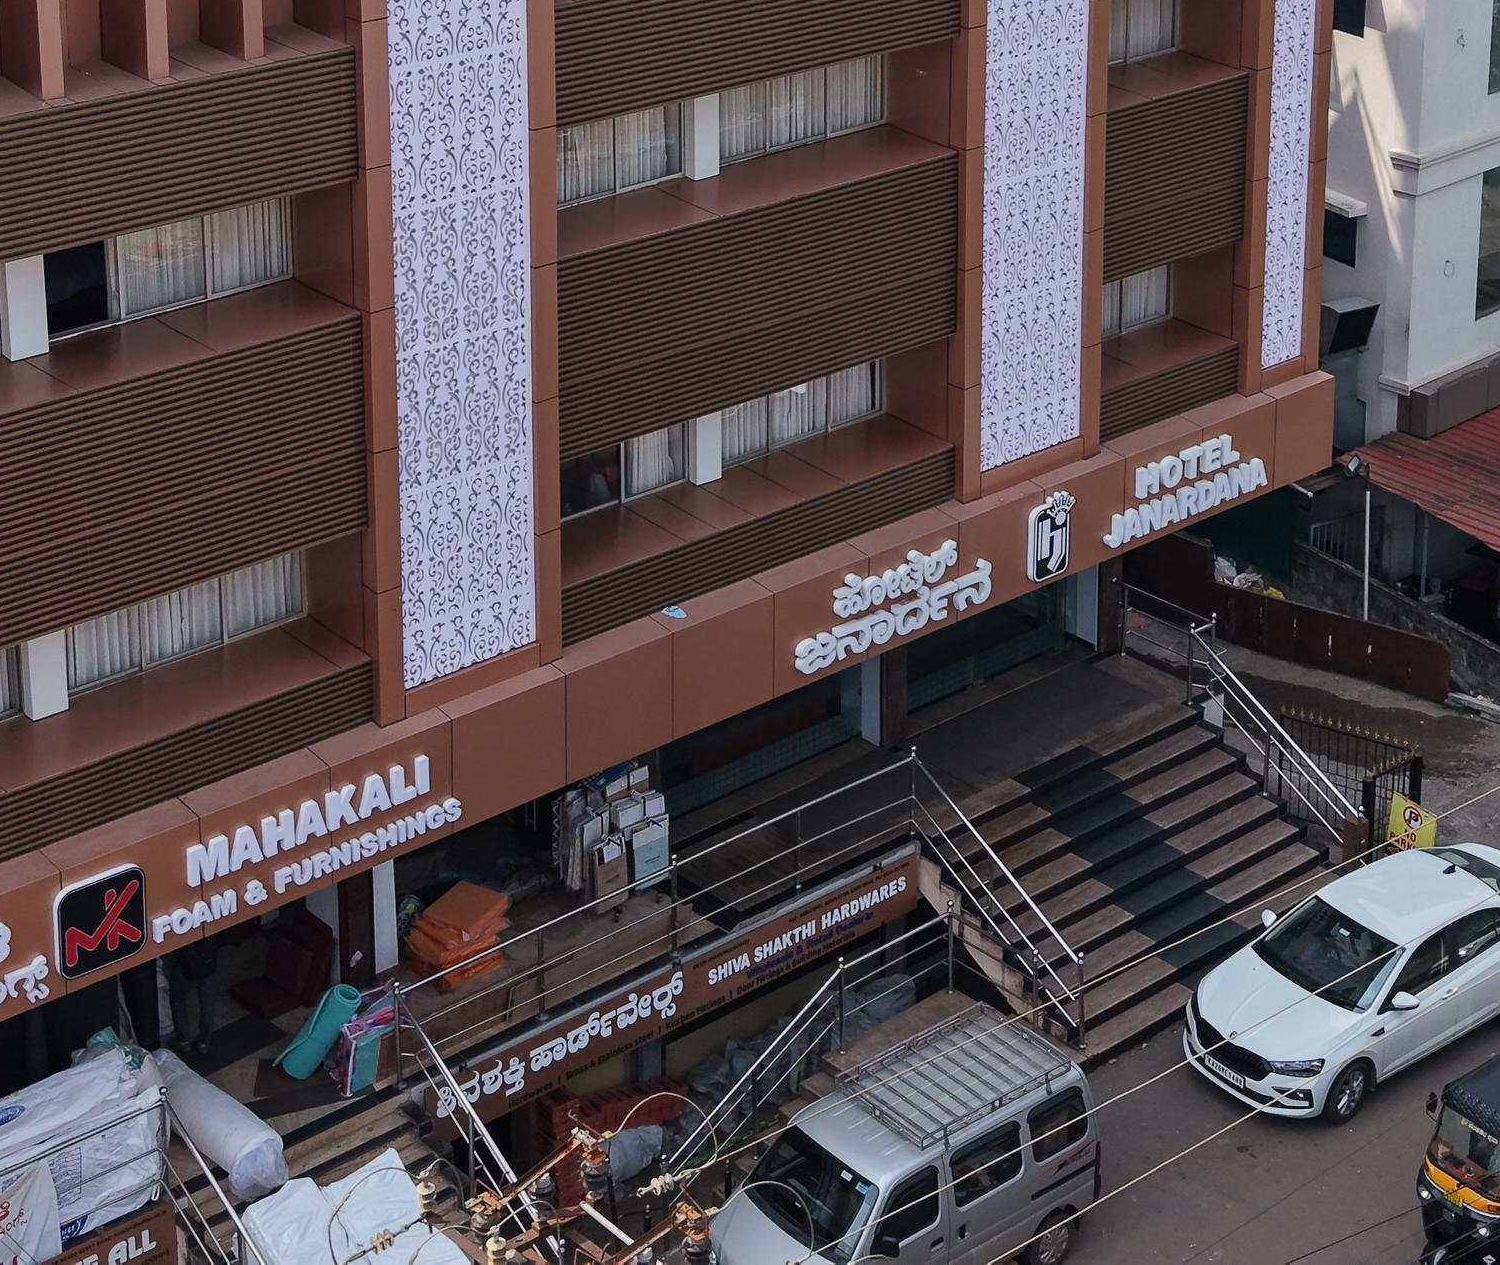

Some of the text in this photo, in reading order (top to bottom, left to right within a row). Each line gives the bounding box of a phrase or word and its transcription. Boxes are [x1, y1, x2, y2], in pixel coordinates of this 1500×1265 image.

[1103, 456, 1269, 549] JANARDANA
[1134, 433, 1241, 500] HOTEL
[833, 539, 957, 618] ಹೋಟೆಲ್
[186, 754, 431, 888] MAHAKALI
[153, 796, 462, 944] FOAM & FURNISHINGS
[707, 953, 751, 985] SHIVA
[754, 919, 816, 963] SHAKTHI
[821, 876, 907, 930] HARDWARES
[566, 1066, 589, 1080] Brass
[666, 1009, 696, 1030] Kitchen
[736, 978, 755, 995] Door
[108, 1230, 157, 1265] ALL
